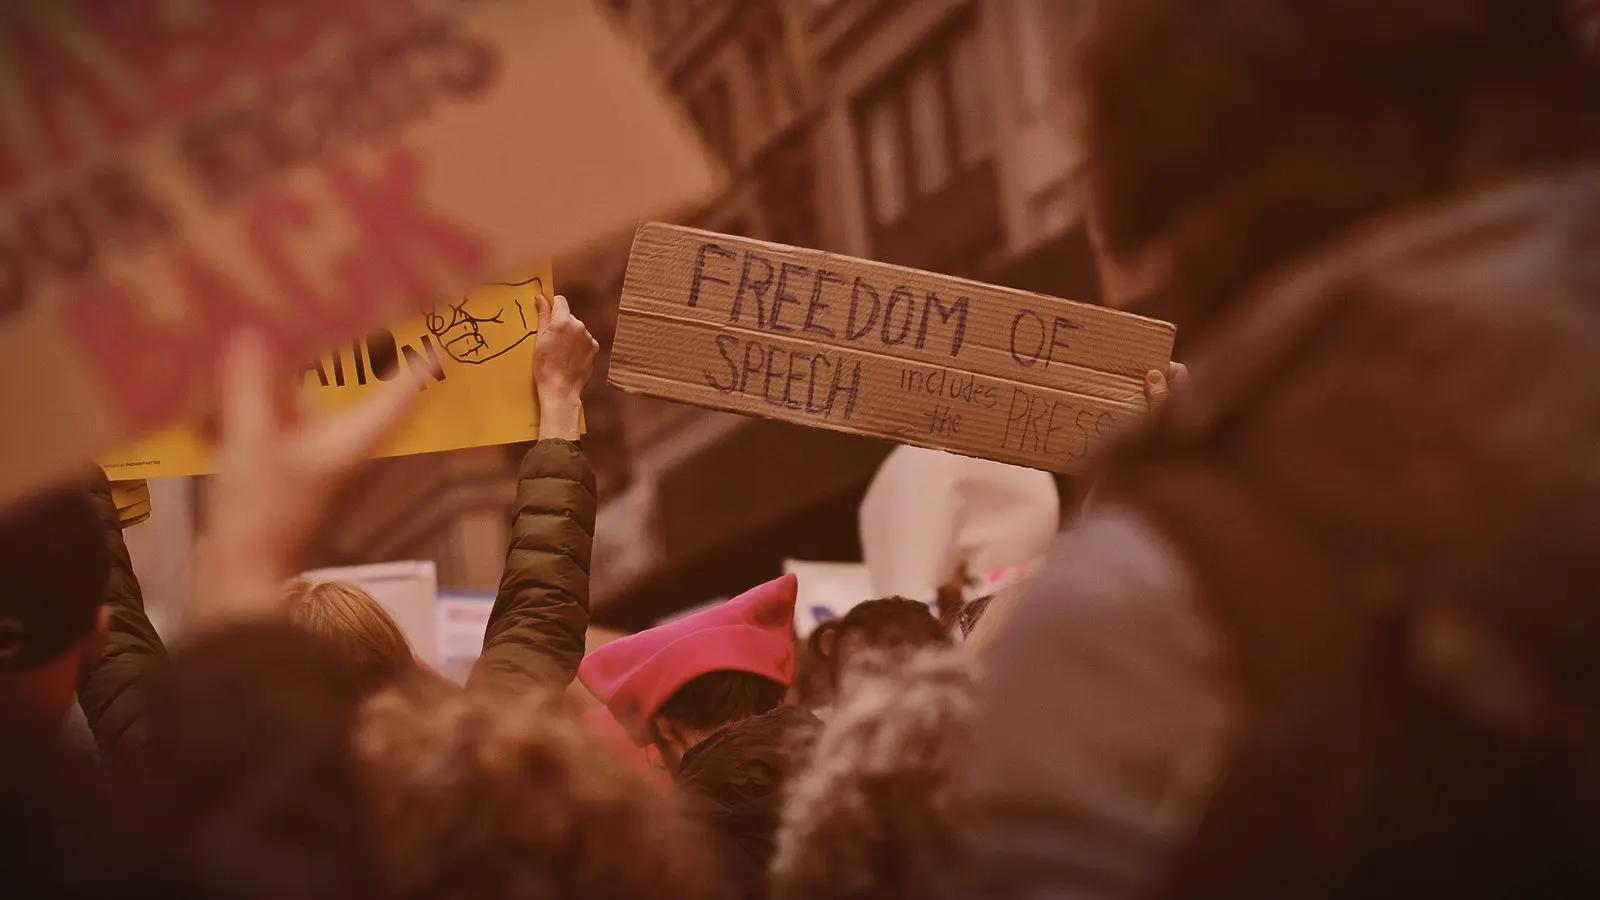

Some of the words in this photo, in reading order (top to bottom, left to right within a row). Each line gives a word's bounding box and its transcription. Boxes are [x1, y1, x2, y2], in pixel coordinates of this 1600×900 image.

[687, 243, 970, 356] FREEDOM
[1010, 308, 1083, 368] OF
[703, 334, 861, 420] SPEECH
[899, 367, 998, 410] includes
[926, 406, 961, 436] the
